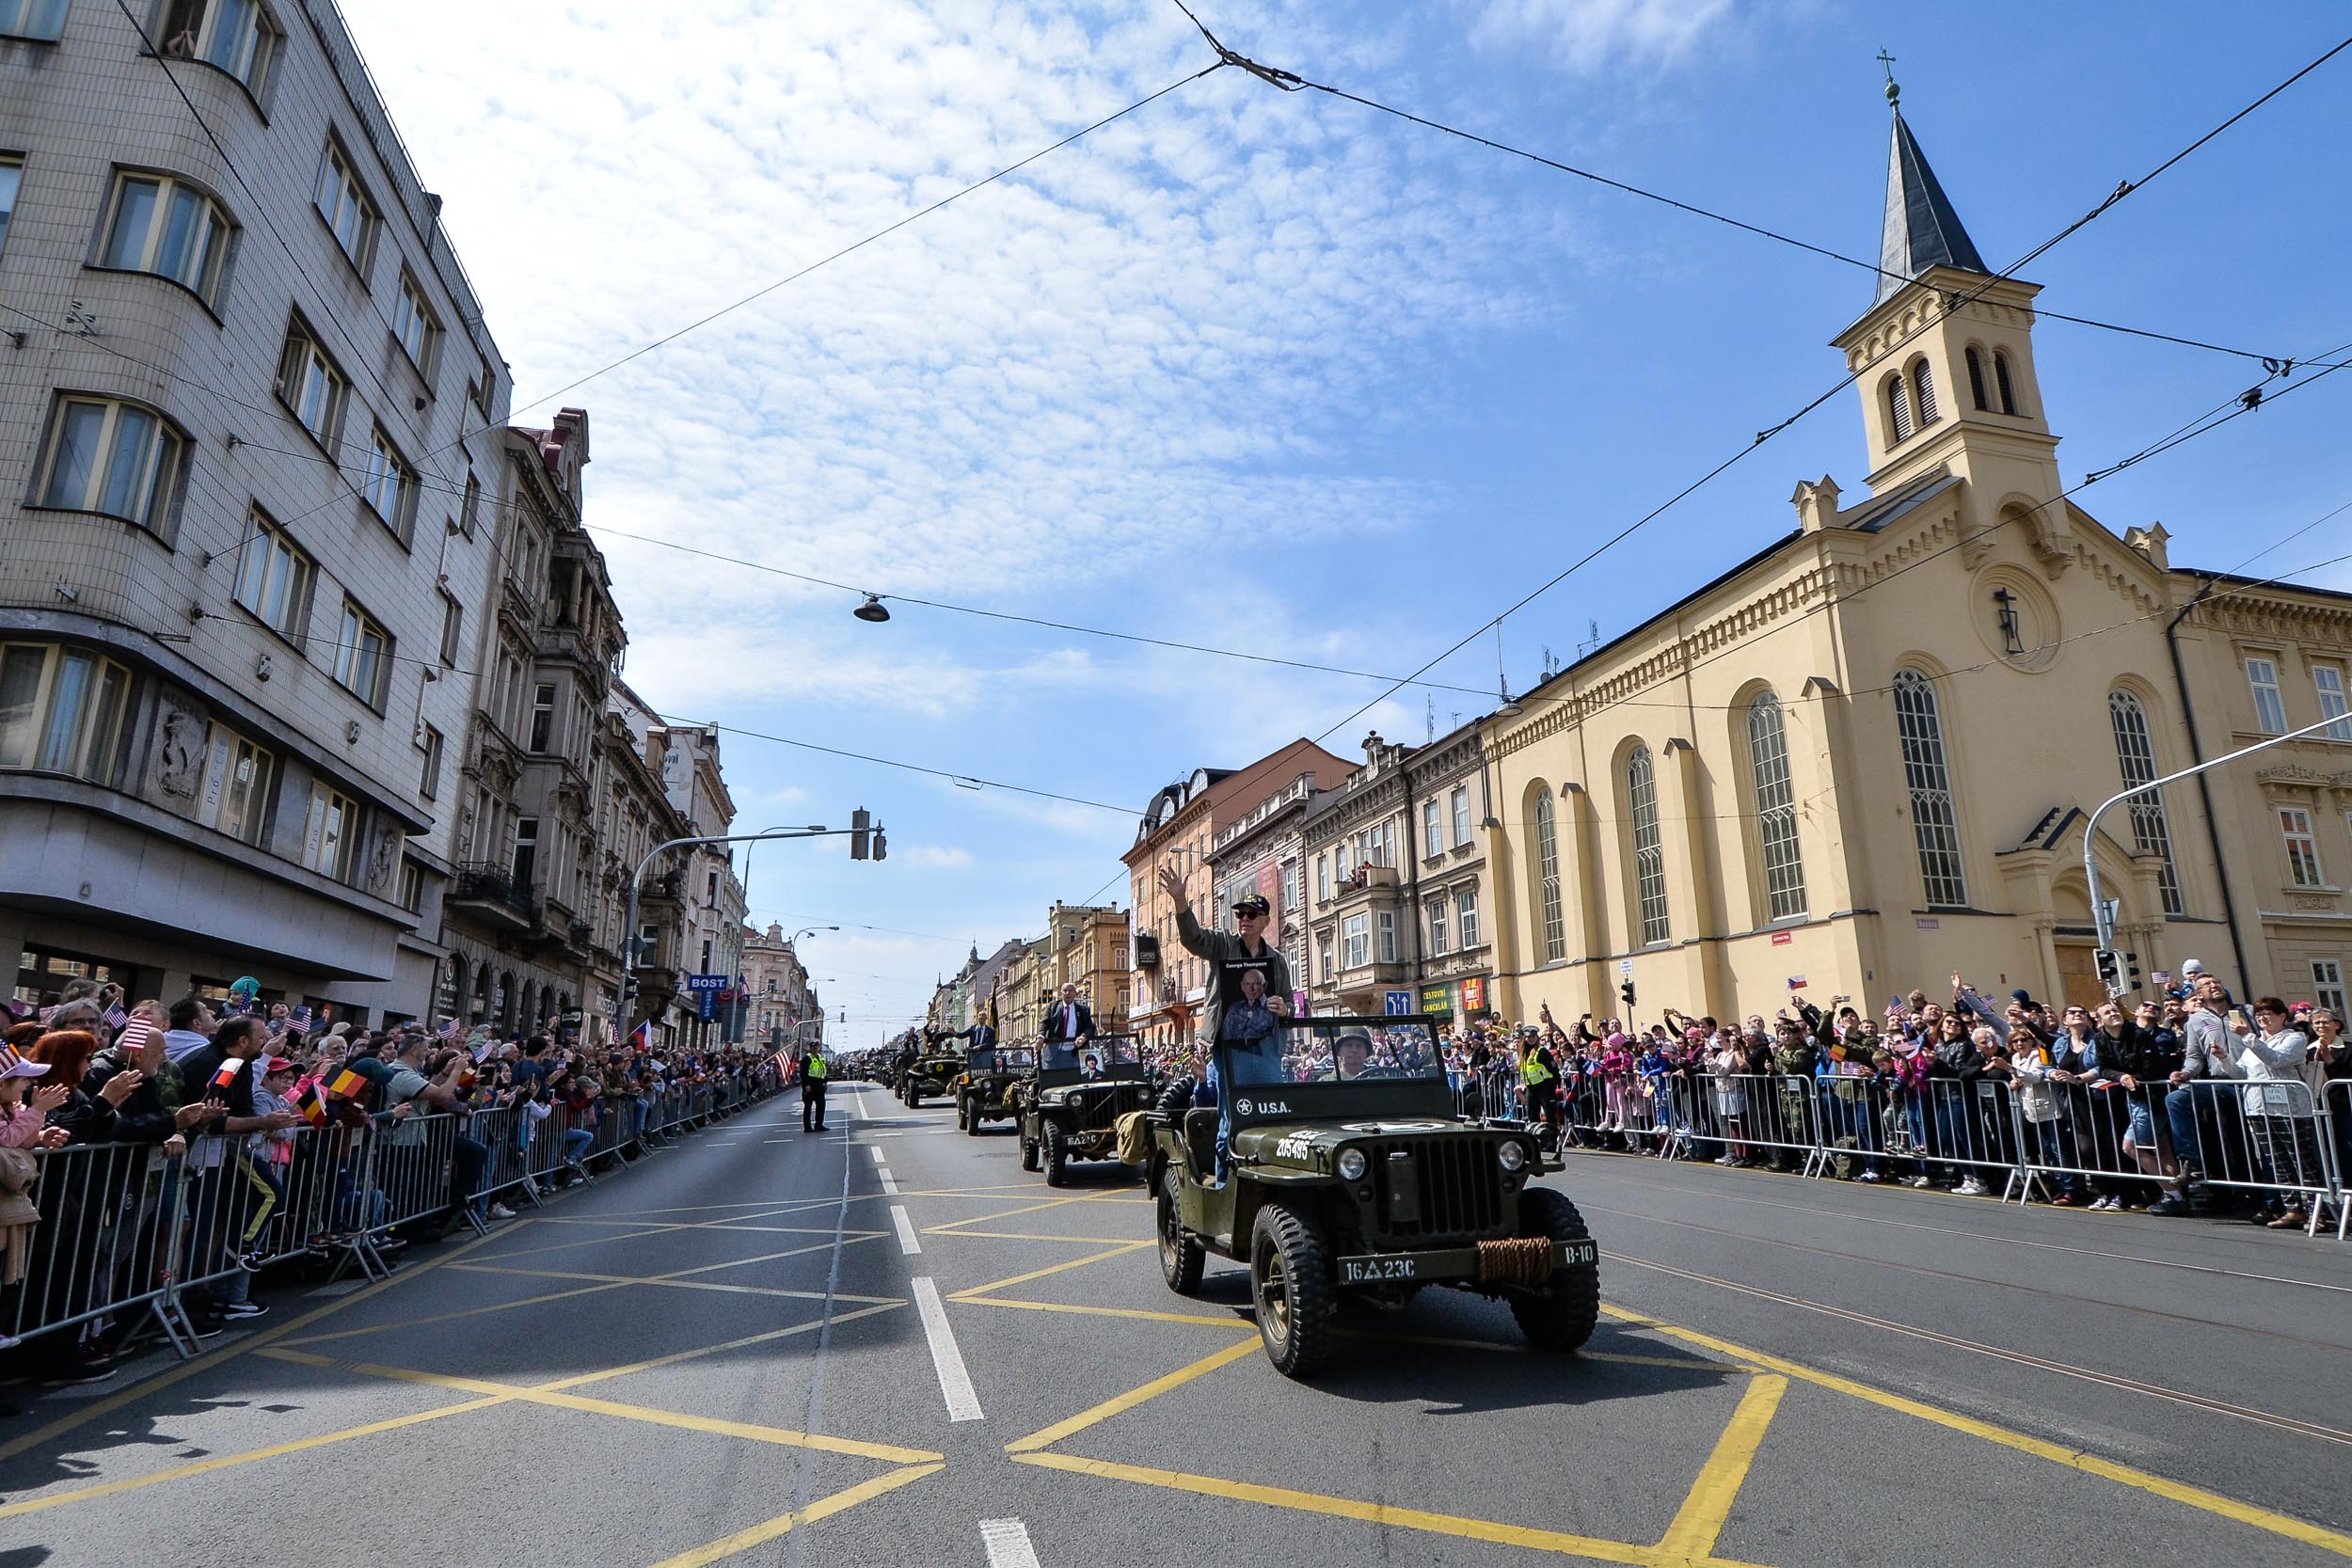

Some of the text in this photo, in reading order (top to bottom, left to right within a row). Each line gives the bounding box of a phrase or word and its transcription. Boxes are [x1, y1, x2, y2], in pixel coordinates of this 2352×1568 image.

[691, 978, 725, 988] BOST
[1007, 1067, 1033, 1075] POLICE
[1258, 1101, 1292, 1115] U.S.A.
